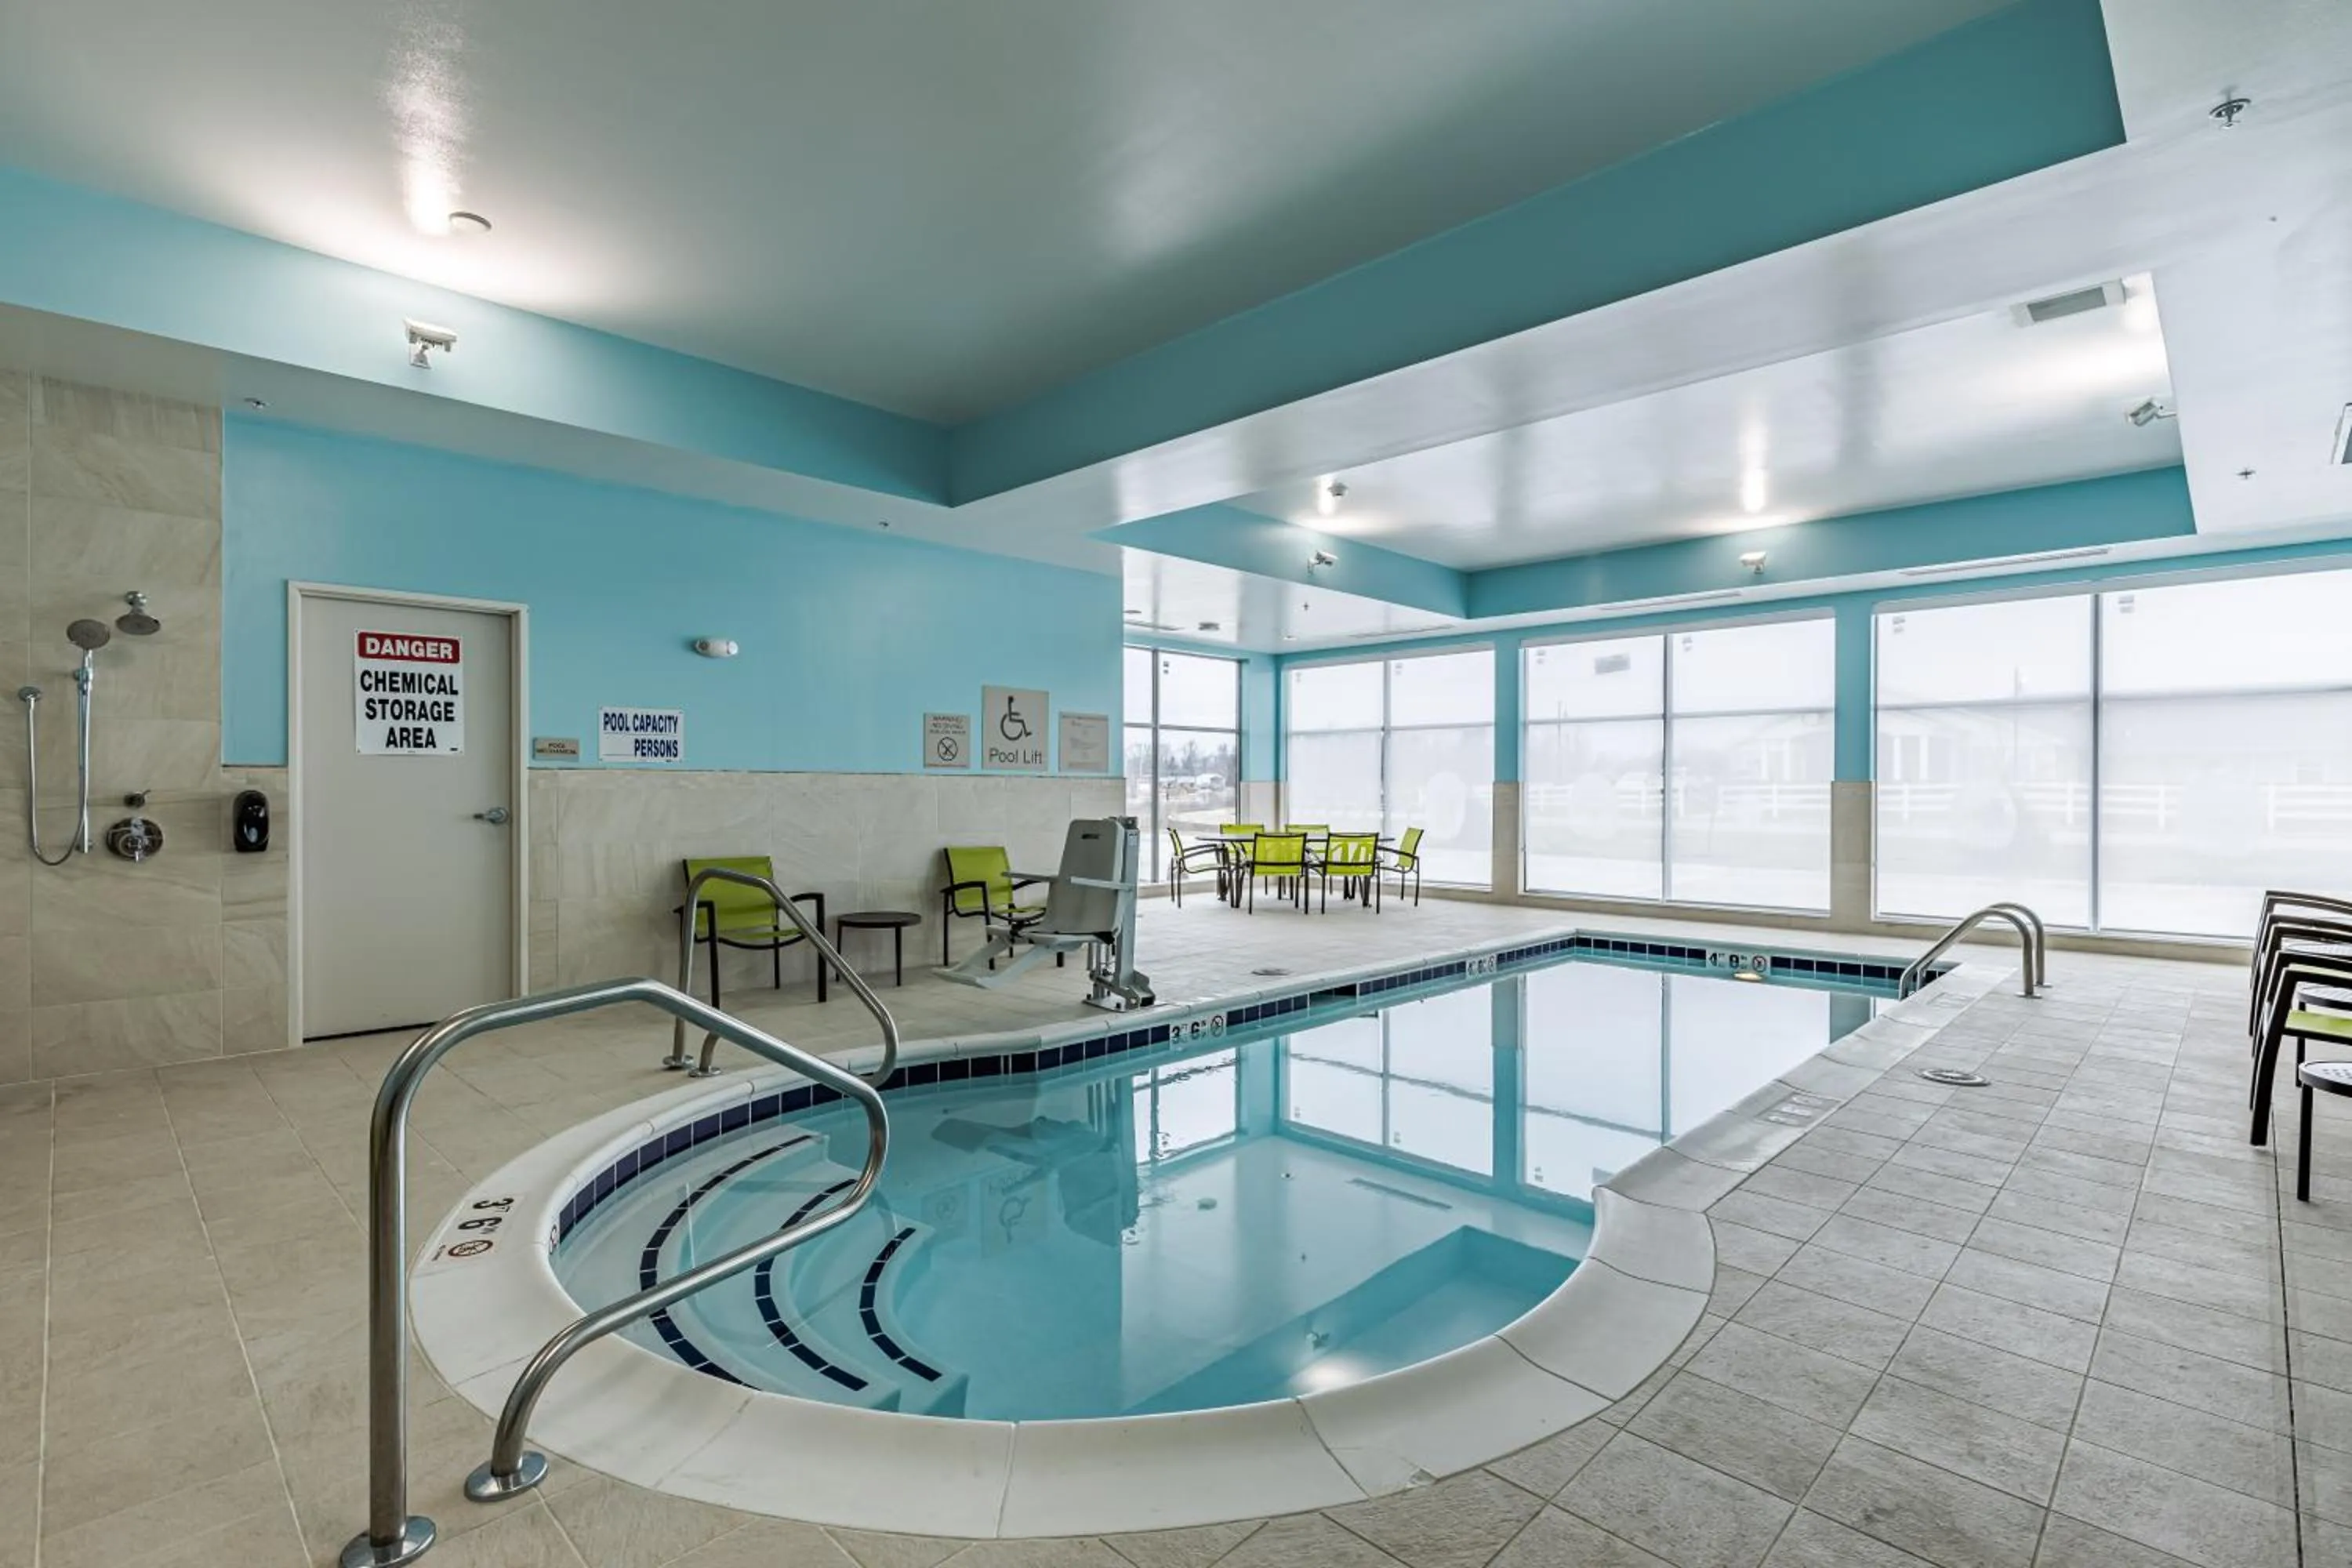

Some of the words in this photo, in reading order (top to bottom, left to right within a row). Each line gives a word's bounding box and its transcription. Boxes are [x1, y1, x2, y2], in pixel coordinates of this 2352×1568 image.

[365, 637, 453, 659] DANGER
[360, 670, 459, 695] CHEMICAL
[365, 698, 455, 722] STORAGE
[604, 713, 630, 731] POOL
[633, 714, 678, 734] CAPACITY
[385, 727, 437, 749] AREA
[634, 739, 678, 758] PERSONS
[989, 747, 1018, 764] Pool
[1023, 749, 1043, 765] Lift
[472, 1197, 514, 1210] 3
[458, 1216, 503, 1230] 6
